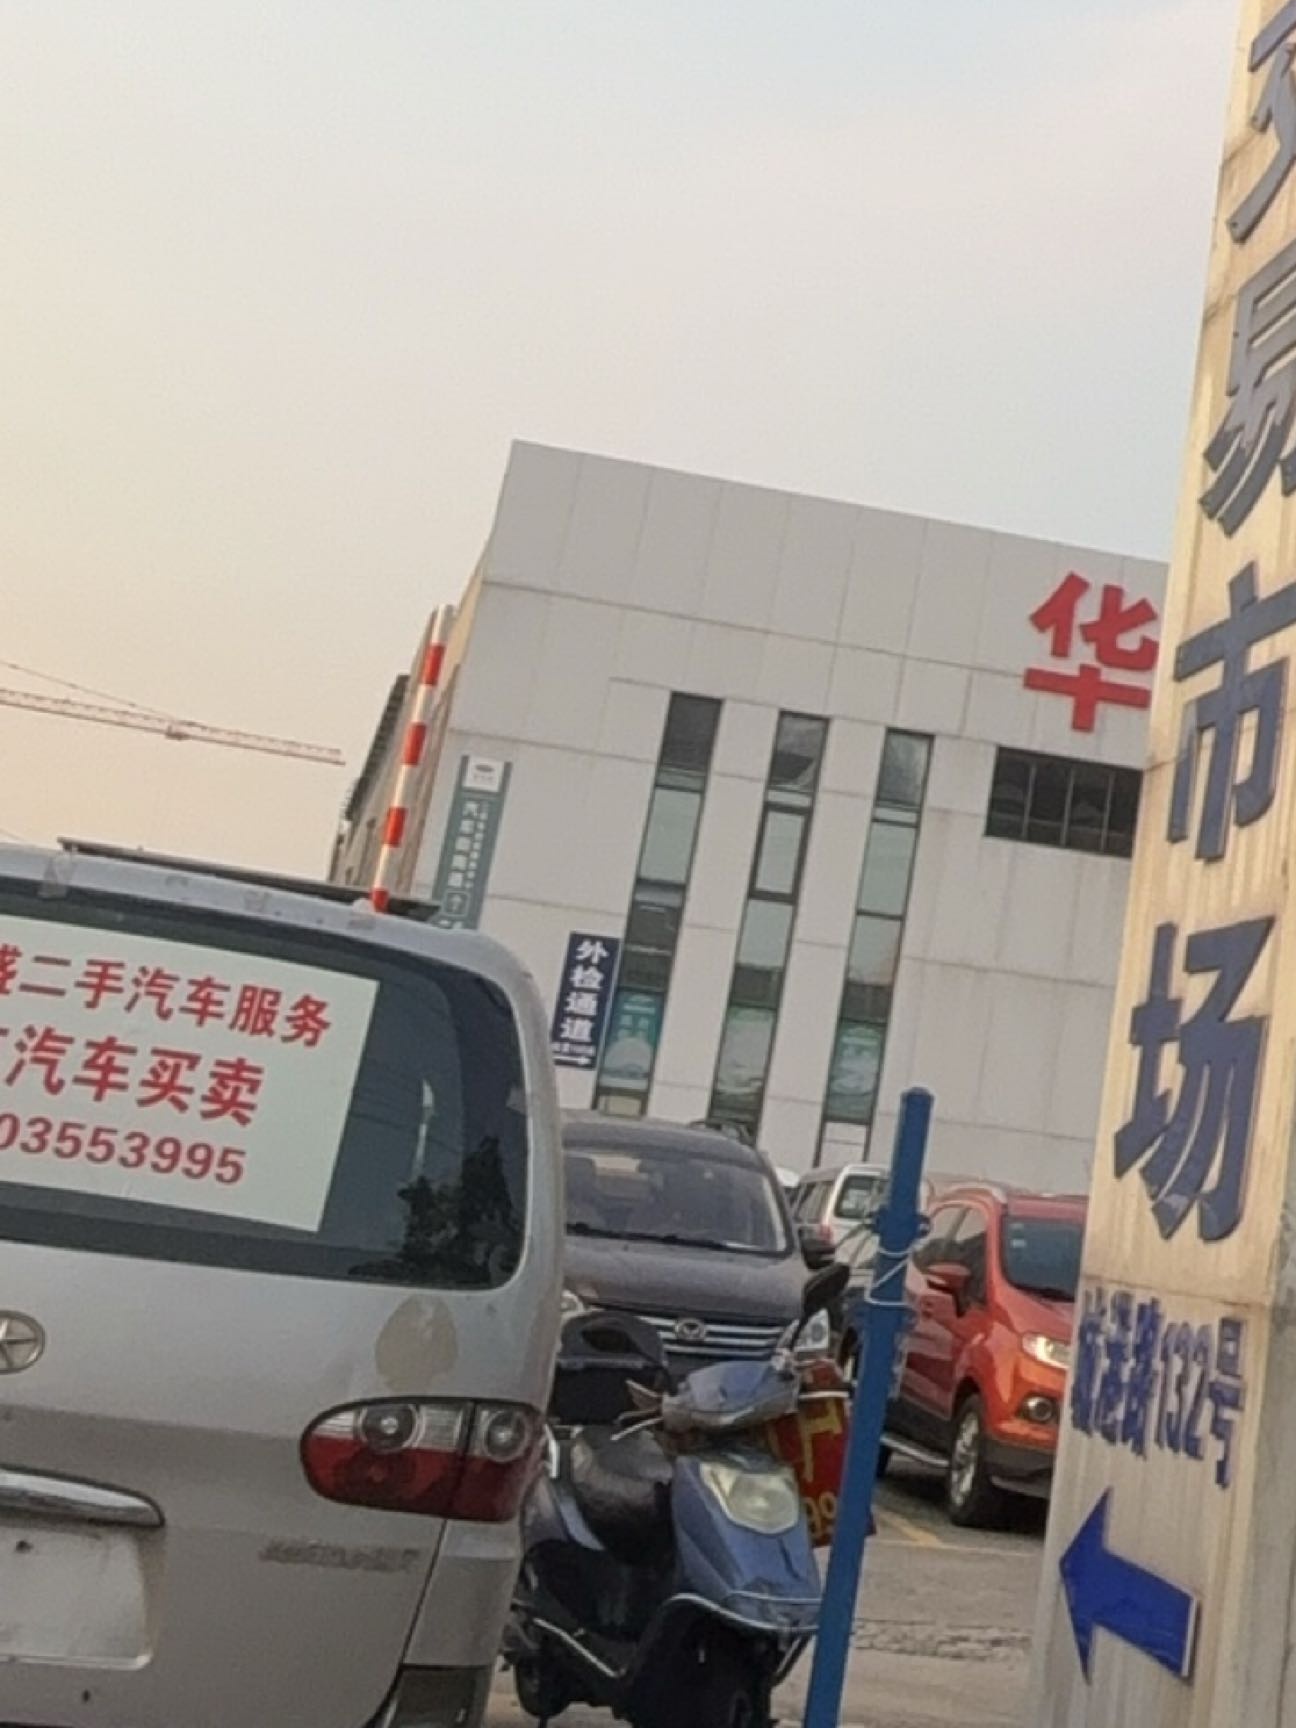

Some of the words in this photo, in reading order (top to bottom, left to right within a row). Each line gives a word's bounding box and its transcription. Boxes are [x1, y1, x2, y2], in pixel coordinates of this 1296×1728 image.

[0, 1024, 266, 1128] 汽车买卖
[0, 1113, 247, 1186] 03553995
